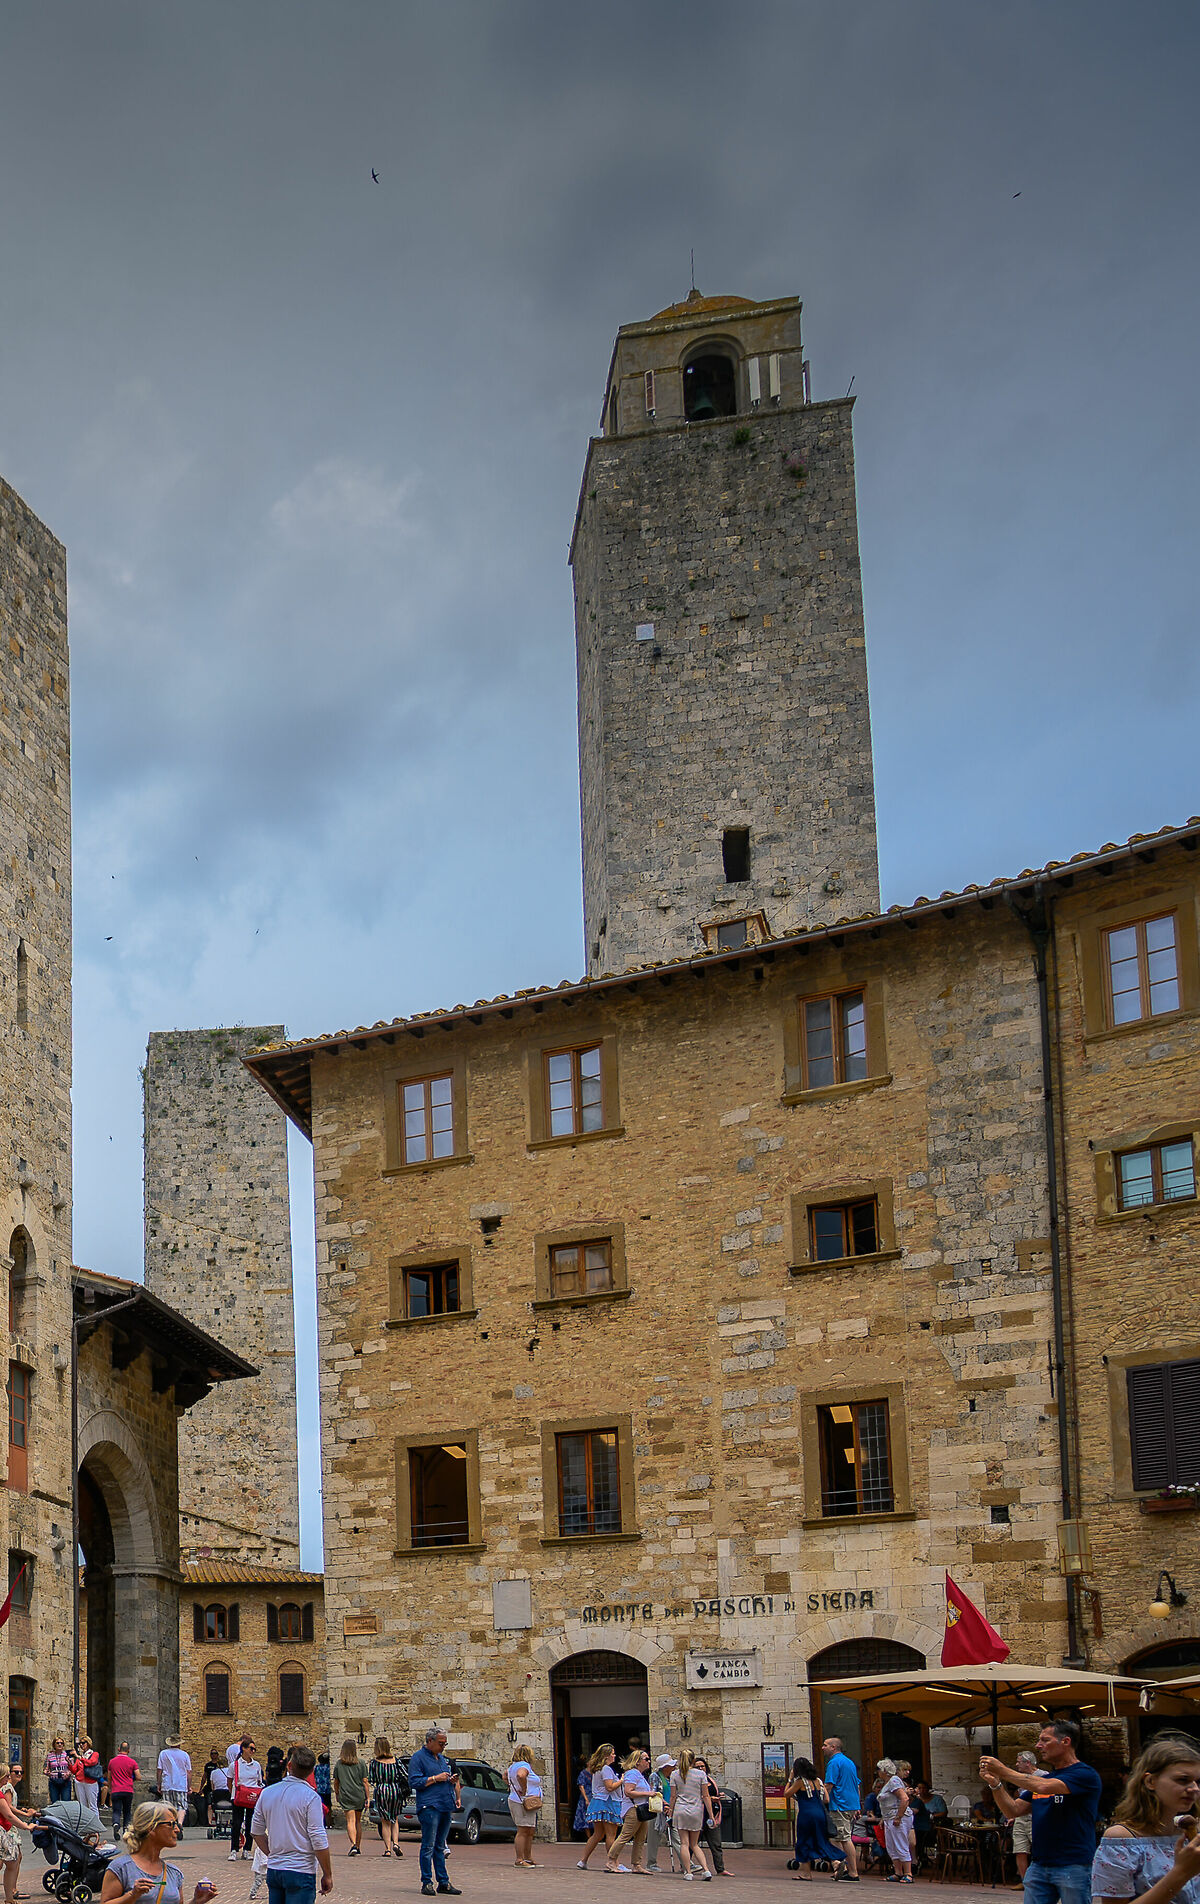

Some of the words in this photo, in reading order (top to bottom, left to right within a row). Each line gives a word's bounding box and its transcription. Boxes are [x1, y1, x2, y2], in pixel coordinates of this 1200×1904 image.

[582, 1603, 654, 1623] MONTE
[664, 1608, 685, 1618] DEI
[692, 1597, 774, 1618] PASCHI
[784, 1600, 796, 1611] DI
[807, 1590, 874, 1612] SIENA
[715, 1660, 748, 1668] BANCA
[713, 1669, 750, 1679] CAMBIO
[1054, 1795, 1064, 1804] 87
